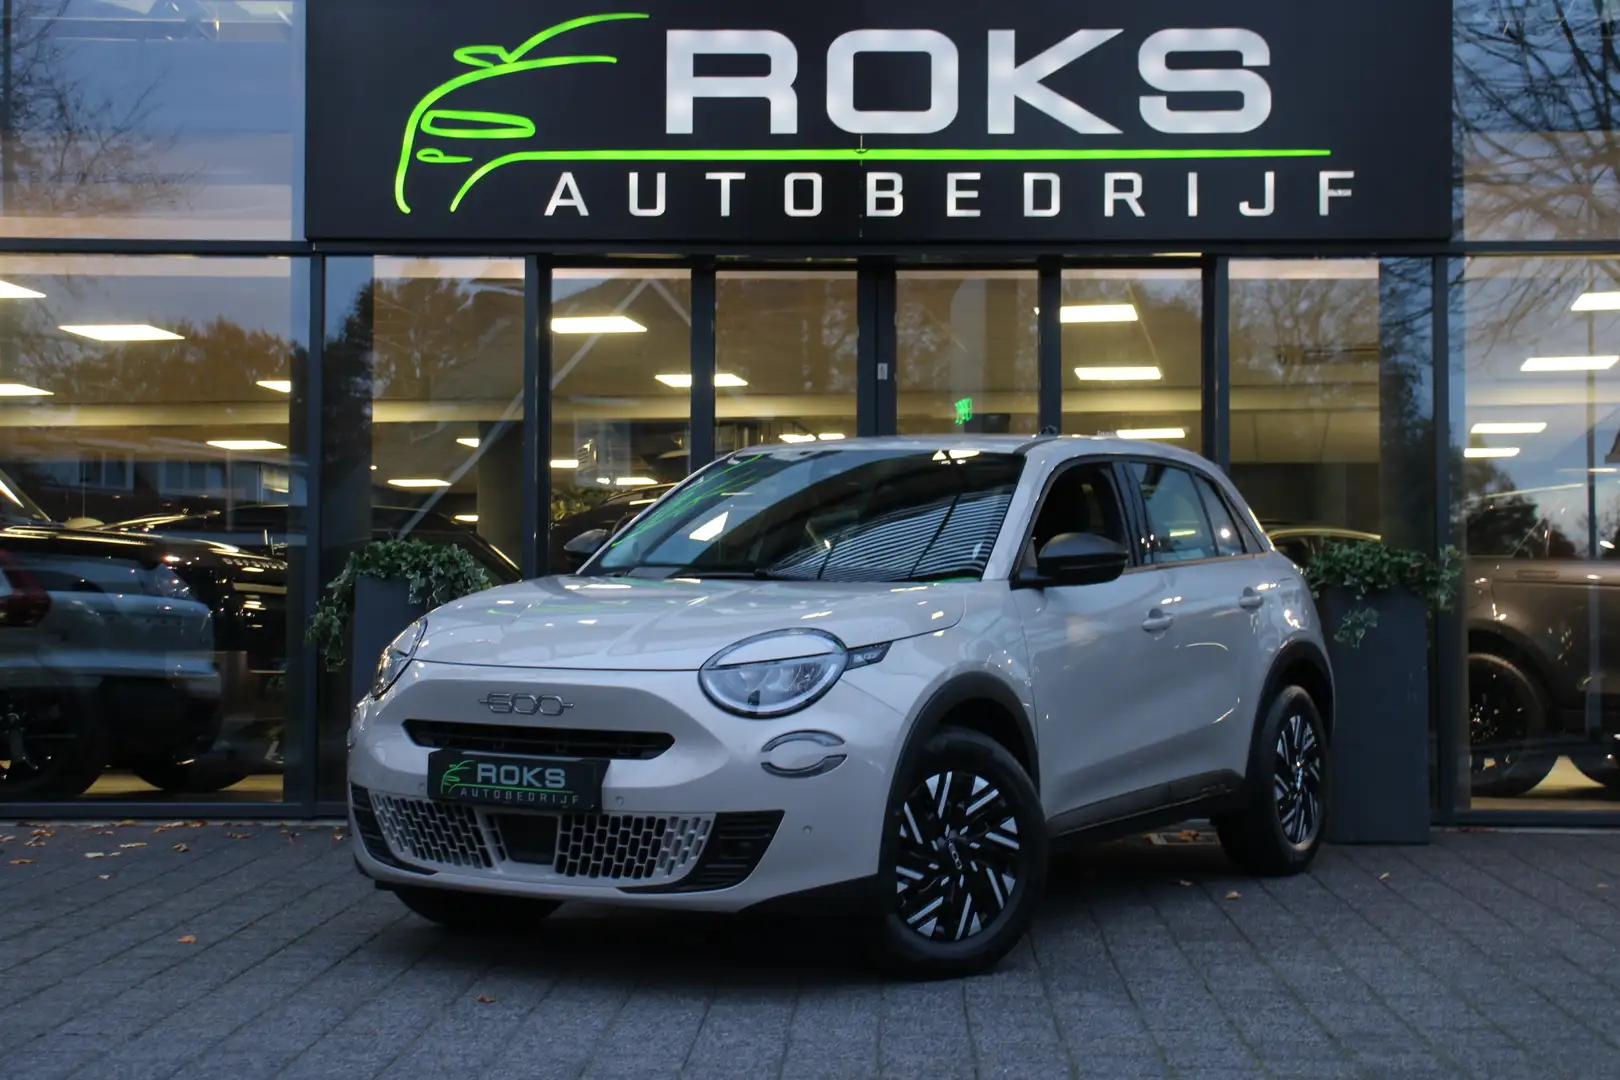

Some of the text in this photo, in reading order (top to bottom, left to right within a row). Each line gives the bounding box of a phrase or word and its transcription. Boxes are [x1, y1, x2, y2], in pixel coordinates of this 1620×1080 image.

[665, 27, 1272, 136] ROKS
[543, 170, 1355, 218] AUTOBEDRIJF
[476, 763, 566, 788] ROKS
[460, 787, 580, 805] AUTOBEDRIJF
